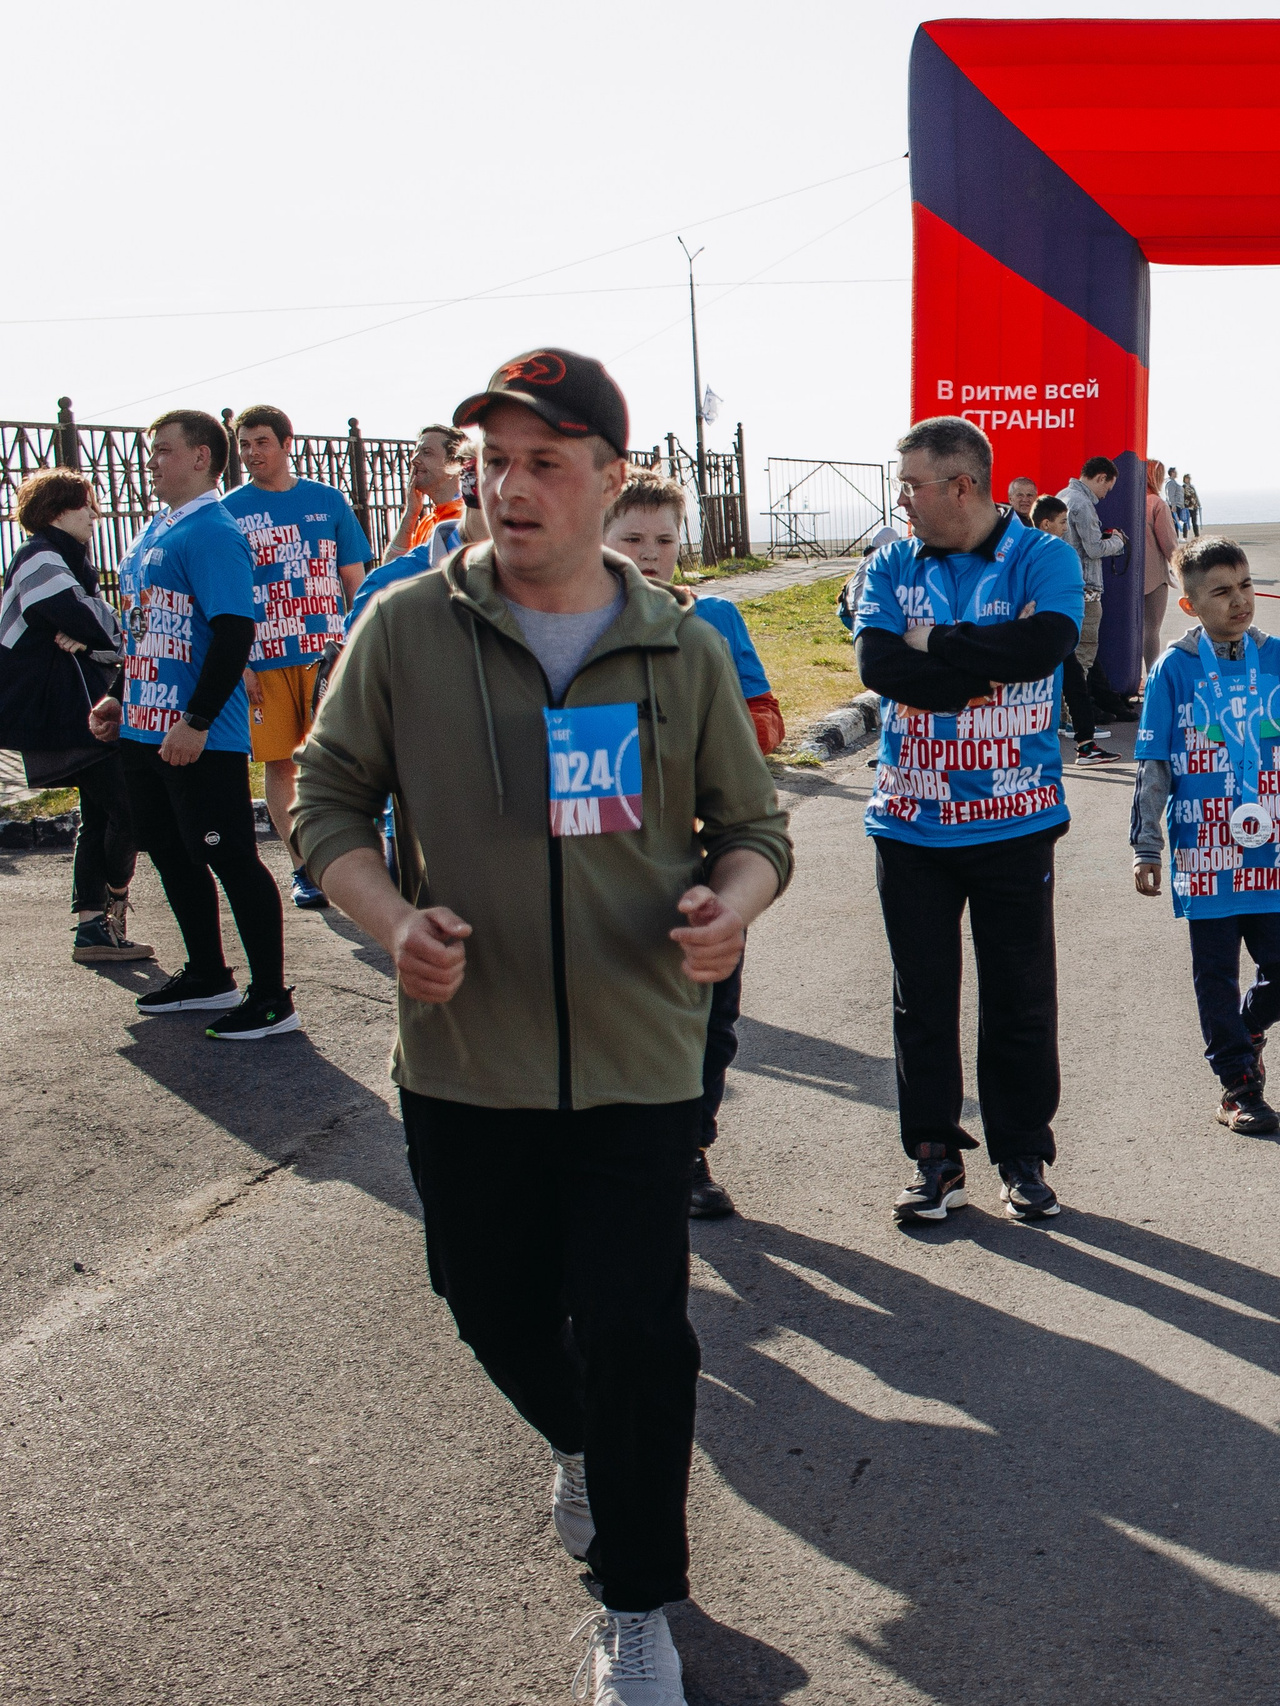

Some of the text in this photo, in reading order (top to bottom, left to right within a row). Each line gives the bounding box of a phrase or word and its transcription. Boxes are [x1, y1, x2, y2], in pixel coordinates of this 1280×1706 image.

[937, 378, 1100, 403] В ритме всей
[236, 511, 274, 535] 2024
[246, 524, 302, 551] #МЕЧТА
[1001, 536, 1015, 553] ПСБ
[264, 595, 339, 621] #ГОРДОСТЬ
[140, 681, 179, 709] 2024
[1212, 680, 1224, 699] ПСБ
[957, 700, 1054, 739] #МОМЕНТ
[898, 737, 1021, 771] #ГОРДОСТЬ
[1174, 797, 1234, 824] #ЗАБЕГ
